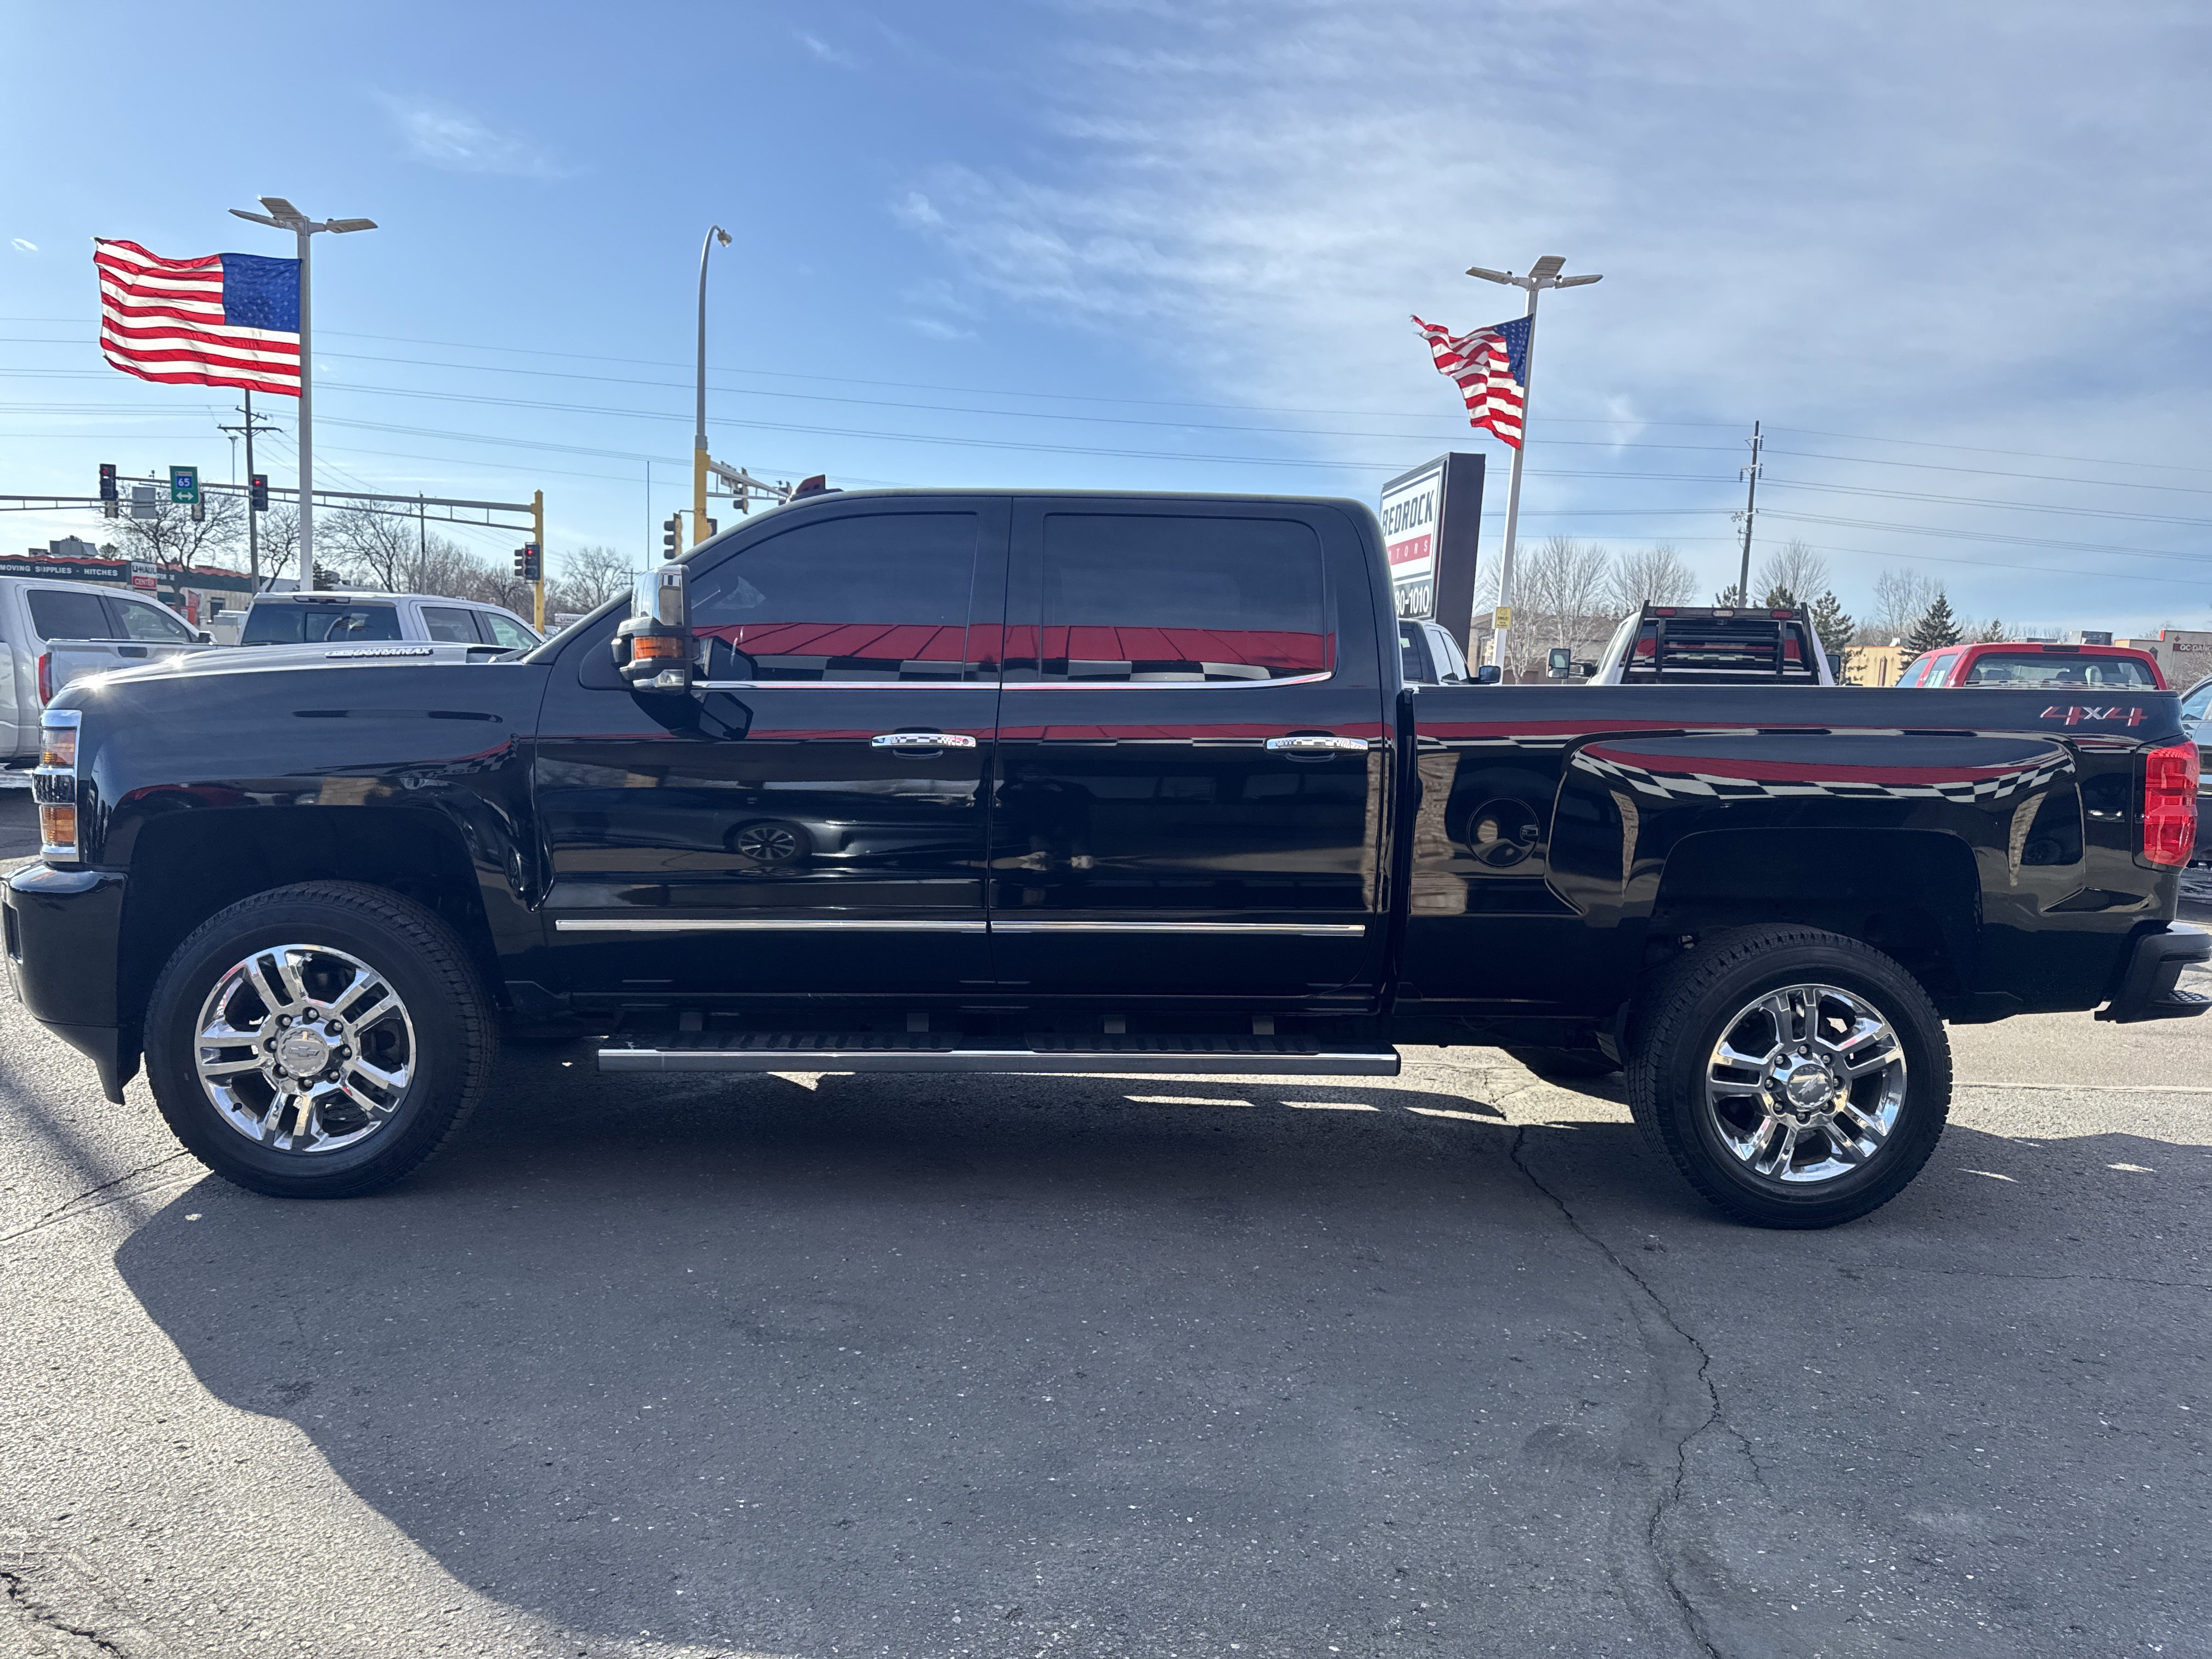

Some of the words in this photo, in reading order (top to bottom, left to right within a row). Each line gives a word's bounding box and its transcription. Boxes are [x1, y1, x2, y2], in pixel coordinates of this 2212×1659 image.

[178, 478, 190, 487] 65
[1383, 489, 1434, 537] BEDROCK
[1388, 539, 1428, 560] OTORS
[35, 566, 72, 574] SUPPLIES
[132, 565, 156, 574] U-HAUL
[134, 578, 155, 586] CENTER
[1395, 585, 1430, 616] 80-1010
